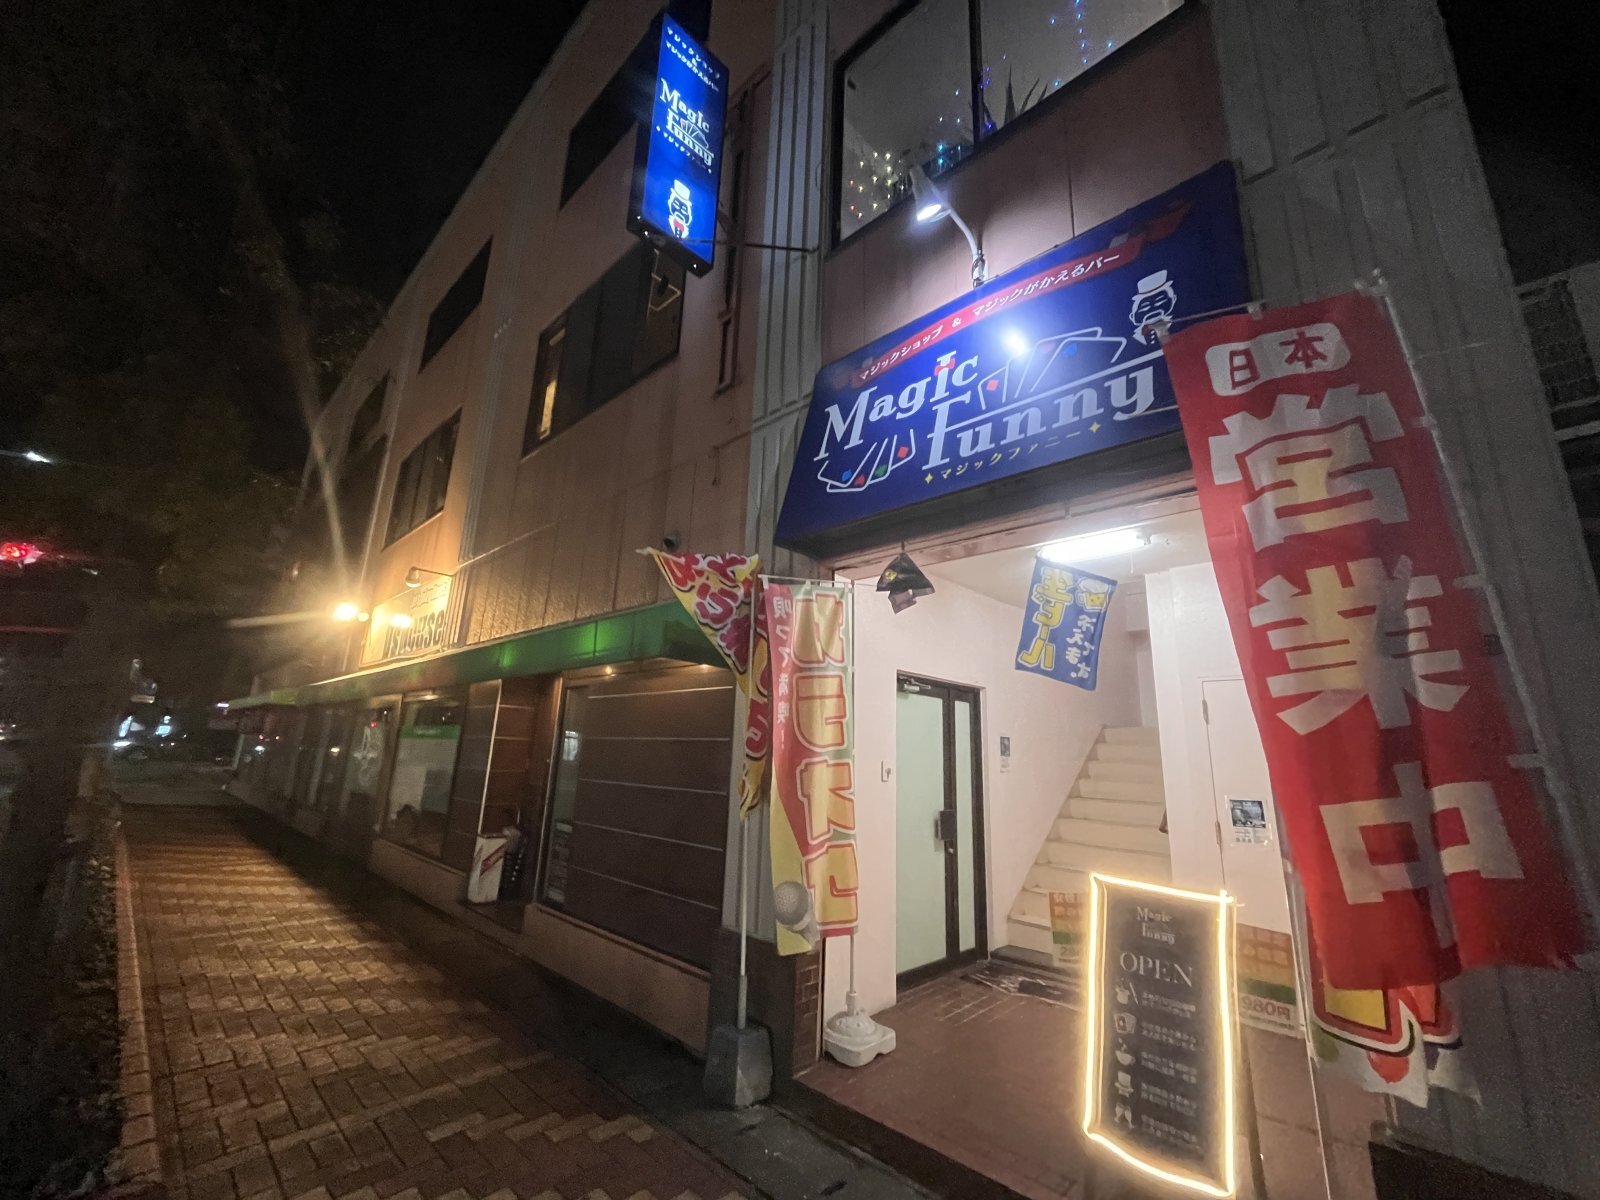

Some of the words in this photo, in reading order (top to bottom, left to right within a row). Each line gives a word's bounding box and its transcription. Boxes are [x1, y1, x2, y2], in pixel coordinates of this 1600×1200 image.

[659, 78, 710, 133] Magic
[665, 107, 714, 166] Funny
[860, 325, 944, 380] マジックショップ
[951, 317, 962, 328] &
[972, 254, 1120, 317] マジックがかえるバー
[1227, 330, 1332, 391] 日本
[813, 350, 979, 462] Magic
[921, 364, 1156, 472] Funny
[939, 430, 1082, 480] マジックファニー
[1210, 383, 1525, 951] 営業中
[1119, 951, 1193, 988] OPEN
